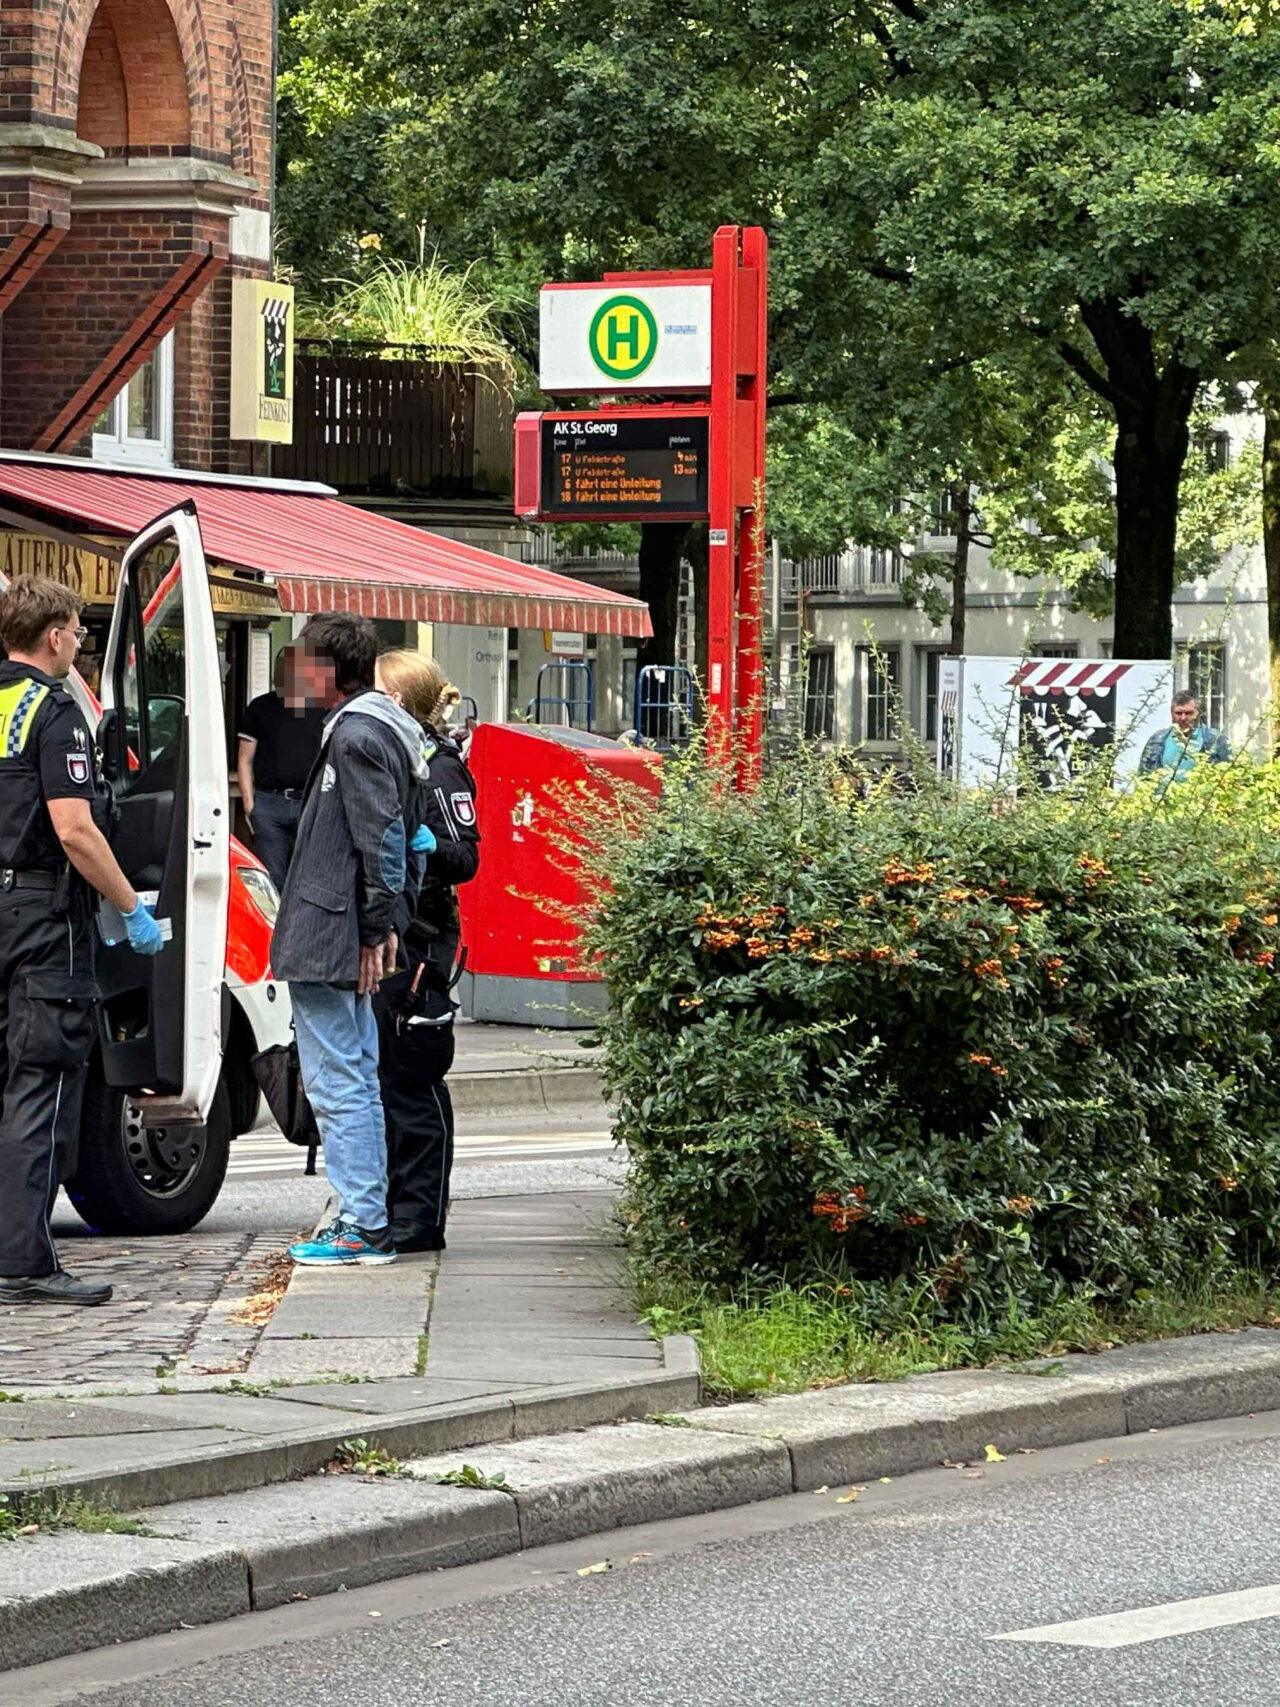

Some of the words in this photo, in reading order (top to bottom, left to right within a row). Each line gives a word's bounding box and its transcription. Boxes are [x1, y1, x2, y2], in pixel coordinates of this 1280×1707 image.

[607, 315, 639, 360] H
[553, 421, 569, 434] AK
[570, 421, 584, 434] St.
[585, 421, 618, 437] Georg
[561, 453, 571, 464] 17
[561, 465, 571, 476] 17
[673, 463, 684, 475] 13
